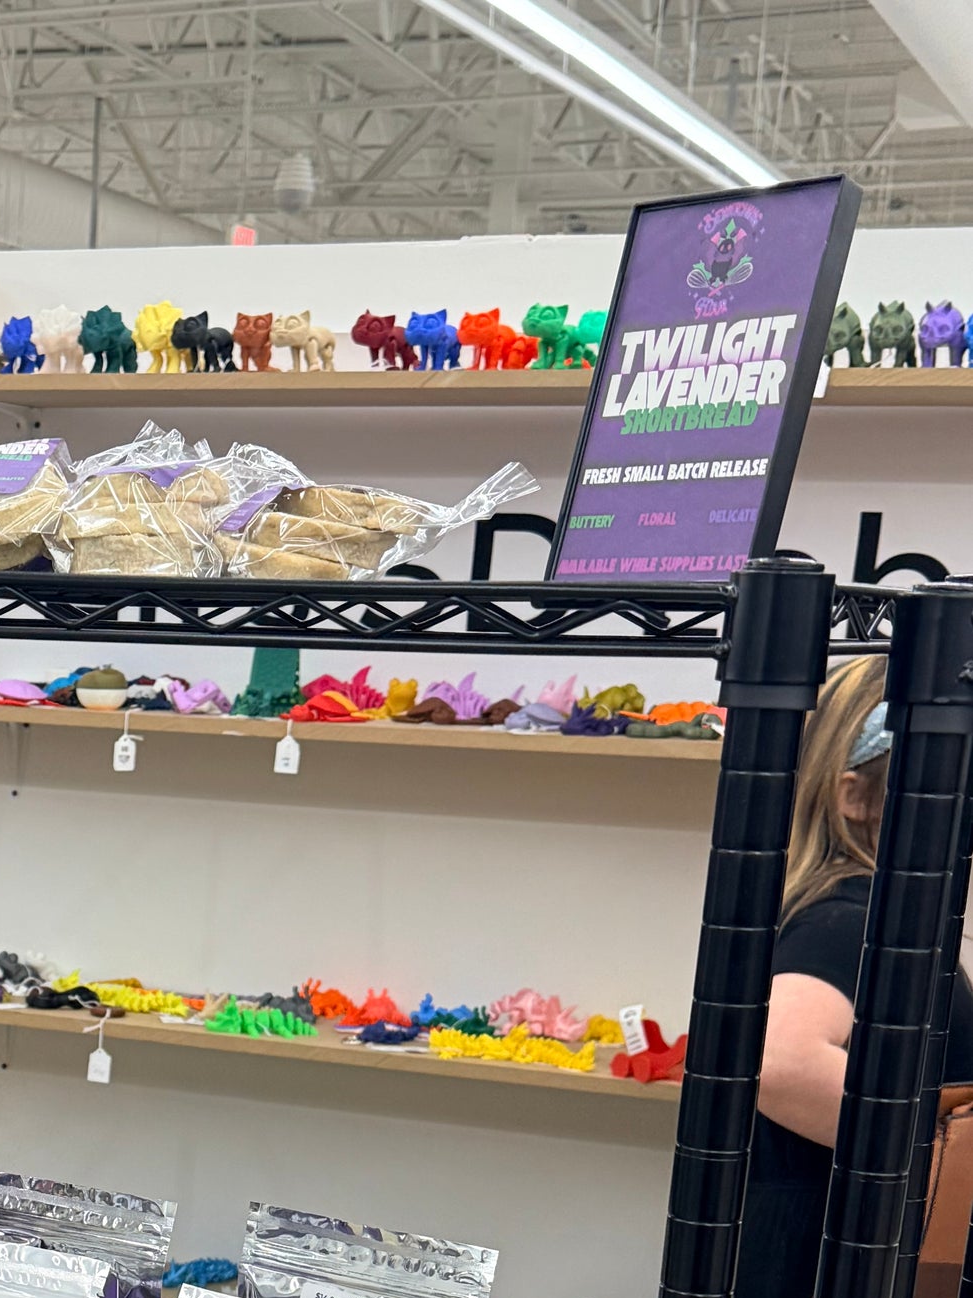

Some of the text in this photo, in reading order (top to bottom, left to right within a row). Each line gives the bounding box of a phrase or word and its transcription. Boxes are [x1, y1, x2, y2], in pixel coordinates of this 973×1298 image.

[620, 314, 797, 374] TWILIGHT
[602, 360, 787, 417] LAVENDER
[620, 400, 759, 435] SHORTBREAD
[582, 458, 769, 485] FRESH SMALL BATCH RELEASE
[569, 509, 757, 529] BUTTERY FLORAL DELICATE
[556, 557, 616, 575] AVAILABLE
[620, 557, 656, 573] WHILE
[659, 556, 716, 573] SUPPLIES
